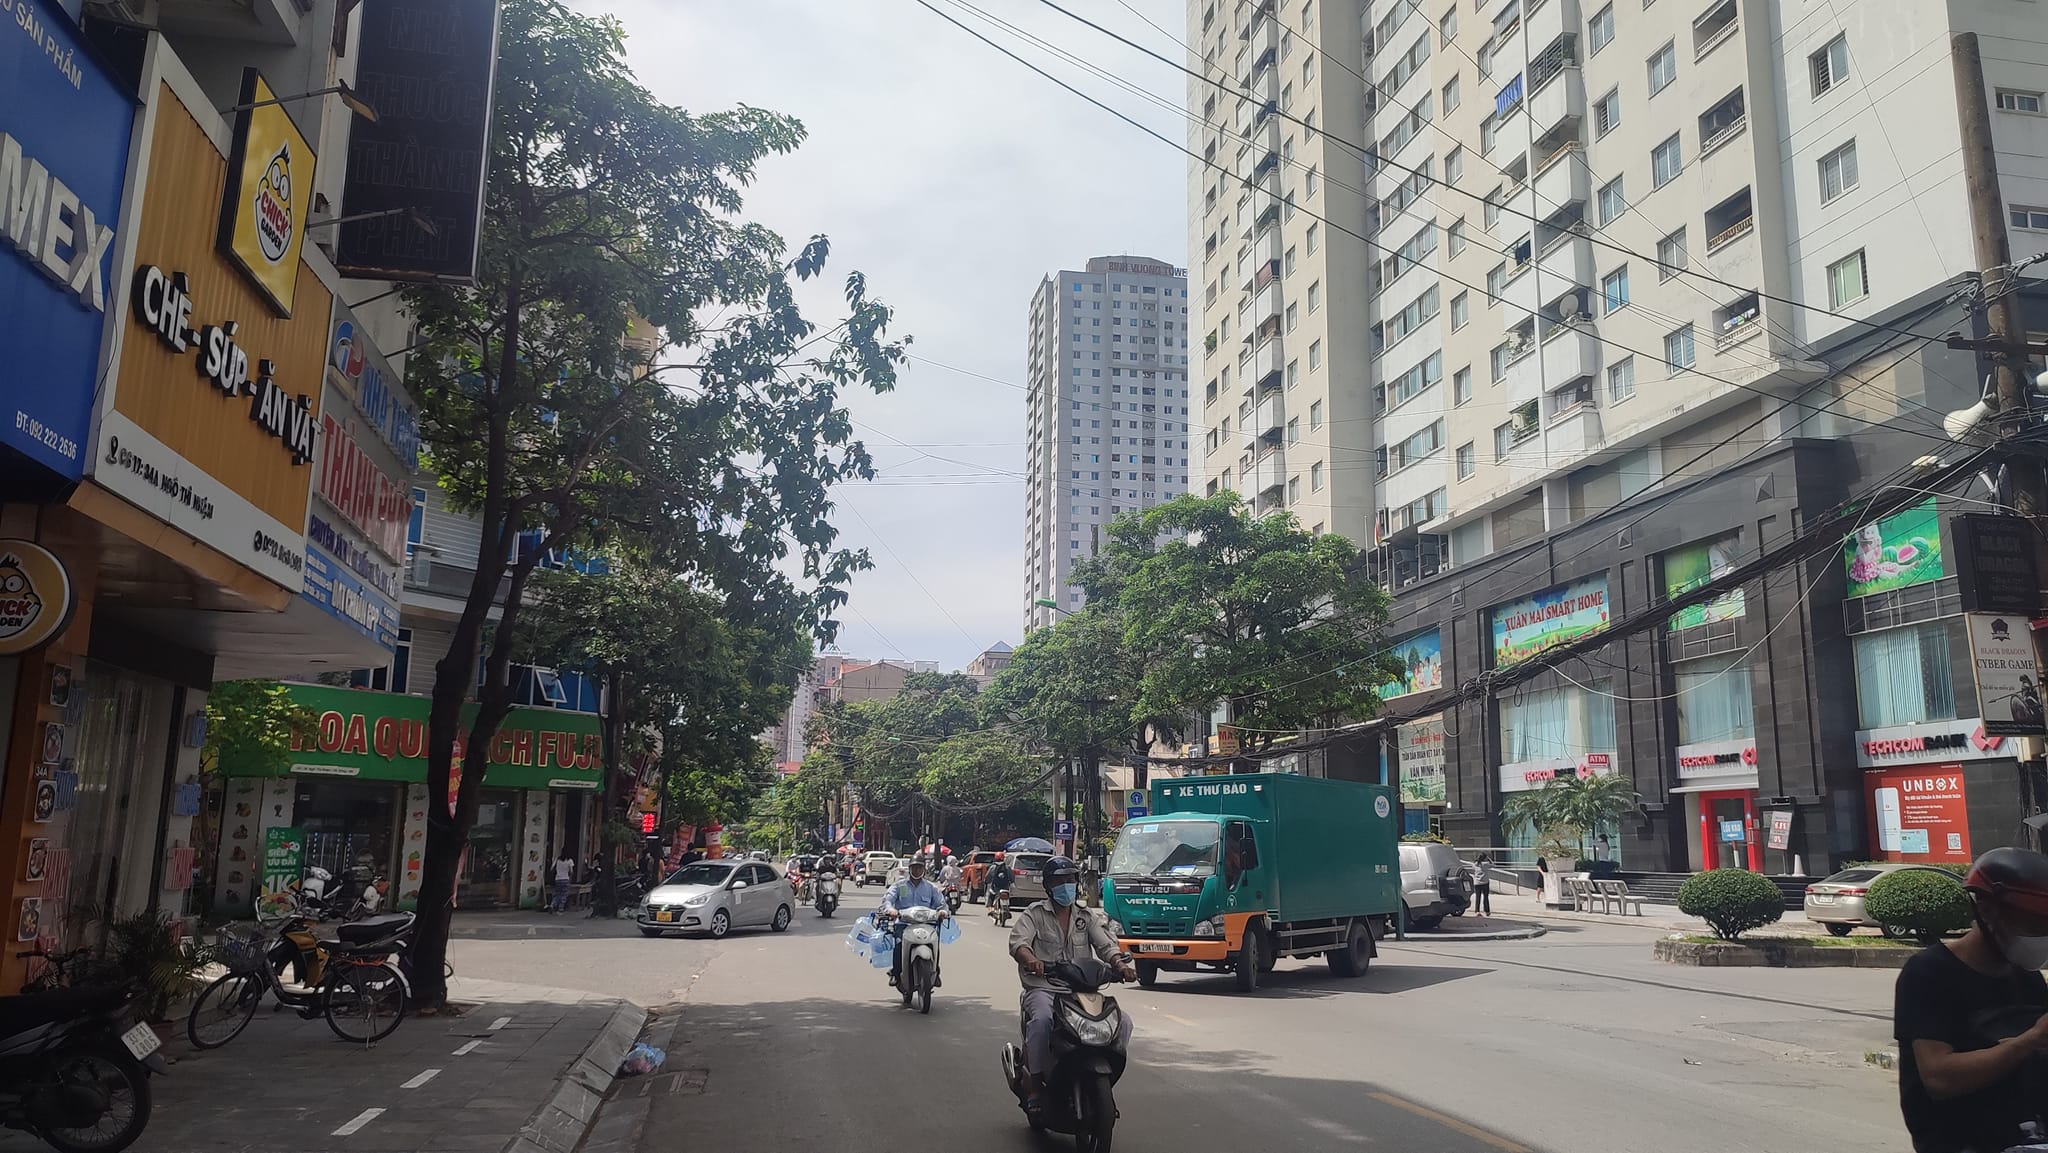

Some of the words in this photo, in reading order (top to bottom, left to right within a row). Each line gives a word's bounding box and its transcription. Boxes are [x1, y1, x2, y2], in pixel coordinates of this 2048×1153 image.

[15, 2, 44, 48] SẢN
[44, 34, 83, 91] PHẨM
[354, 136, 480, 194] THÀNH
[260, 190, 288, 238] CHICK
[260, 218, 283, 252] GARDEN
[1163, 265, 1188, 277] TOWE
[136, 264, 194, 353] CHÈ
[199, 321, 248, 397] SÚP
[254, 359, 288, 437] ĂN
[284, 395, 322, 465] VẶT
[29, 419, 43, 442] 092
[43, 428, 58, 450] 222
[58, 435, 77, 462] 2636
[1505, 611, 1528, 632] XUÂN
[1529, 607, 1545, 625] MAI
[1546, 599, 1576, 620] SMART
[1577, 590, 1604, 611] HOME
[1980, 647, 2001, 656] BLACK
[1976, 658, 2007, 669] CYBER
[2008, 659, 2035, 670] GAME
[373, 716, 431, 762] QU
[537, 730, 602, 770] FUJI
[1861, 733, 1969, 757] TECHCOMBANK
[1588, 754, 1606, 763] ATM
[35, 767, 49, 777] 34A
[1179, 786, 1194, 797] XE
[1196, 783, 1222, 796] THƯ
[1902, 777, 1958, 792] UNBOX
[1059, 823, 1069, 834] P
[1142, 886, 1170, 894] ISUZU
